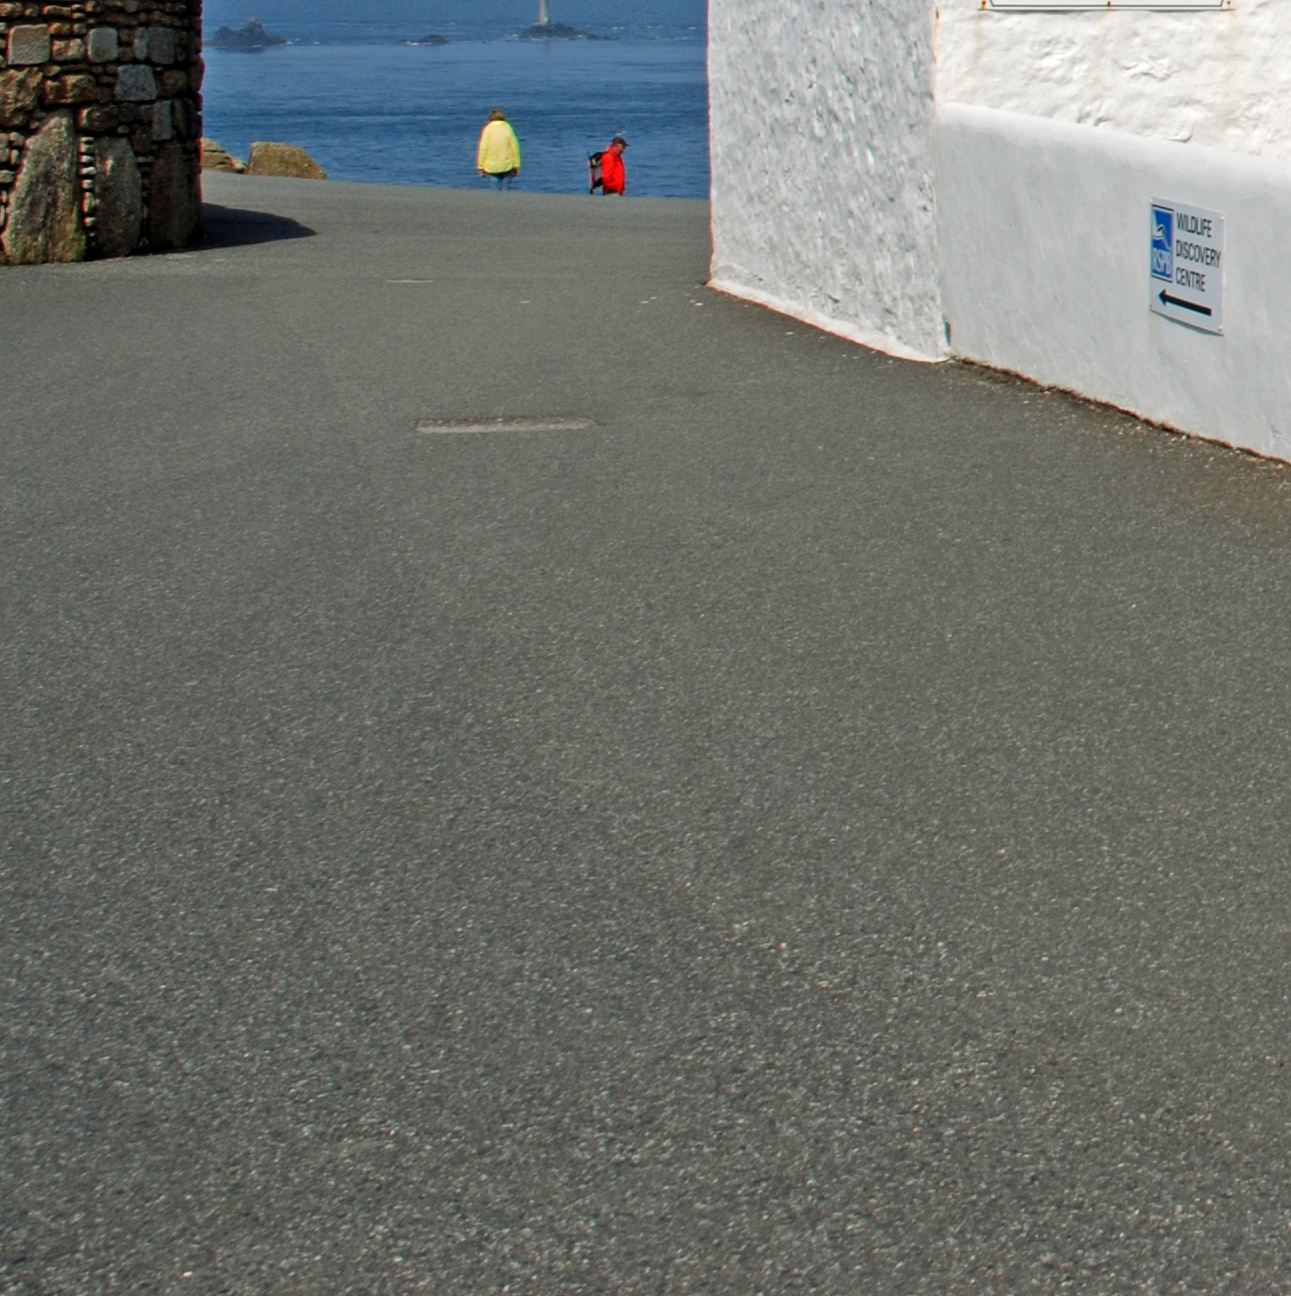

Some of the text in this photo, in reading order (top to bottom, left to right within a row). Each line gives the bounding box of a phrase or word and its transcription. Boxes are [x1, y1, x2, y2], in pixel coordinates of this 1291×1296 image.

[1176, 212, 1212, 238] WILDLIFE
[1175, 239, 1221, 268] DISCOVERY
[1175, 266, 1206, 292] CENTRE
